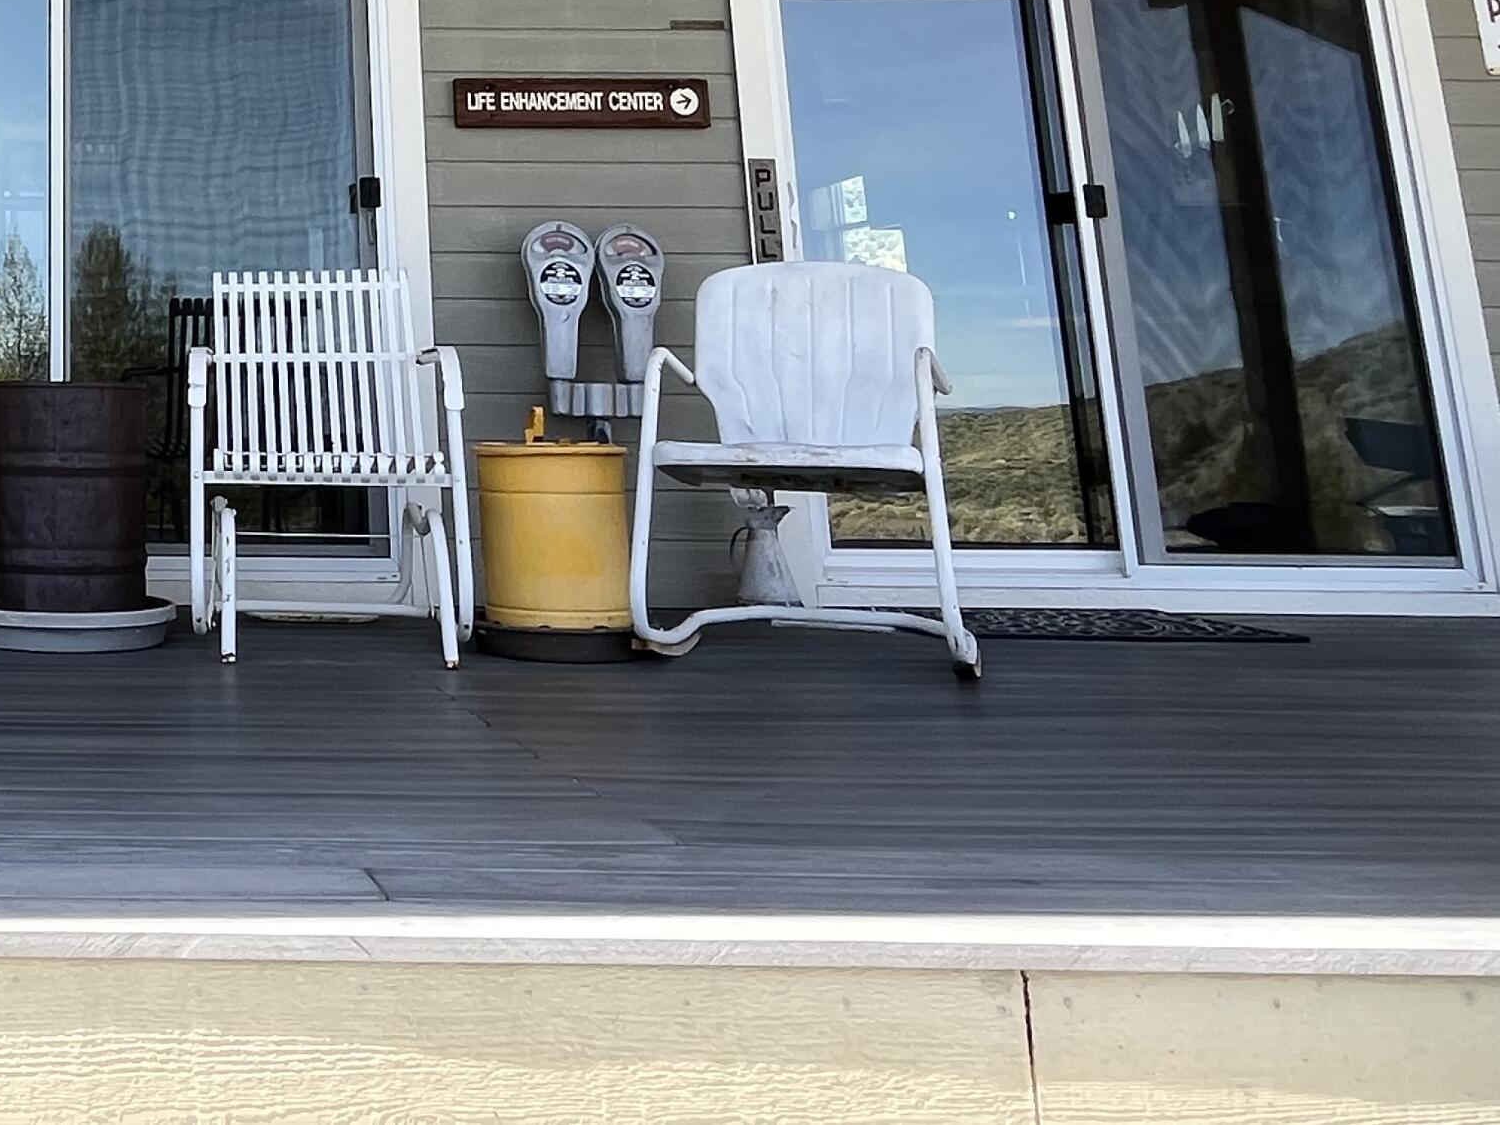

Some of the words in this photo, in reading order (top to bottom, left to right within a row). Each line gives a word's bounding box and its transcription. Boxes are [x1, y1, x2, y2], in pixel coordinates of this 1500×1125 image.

[467, 92, 496, 111] LIFE
[501, 92, 604, 111] ENHANCEMENT
[608, 92, 664, 111] CENTER
[755, 168, 778, 258] PULL
